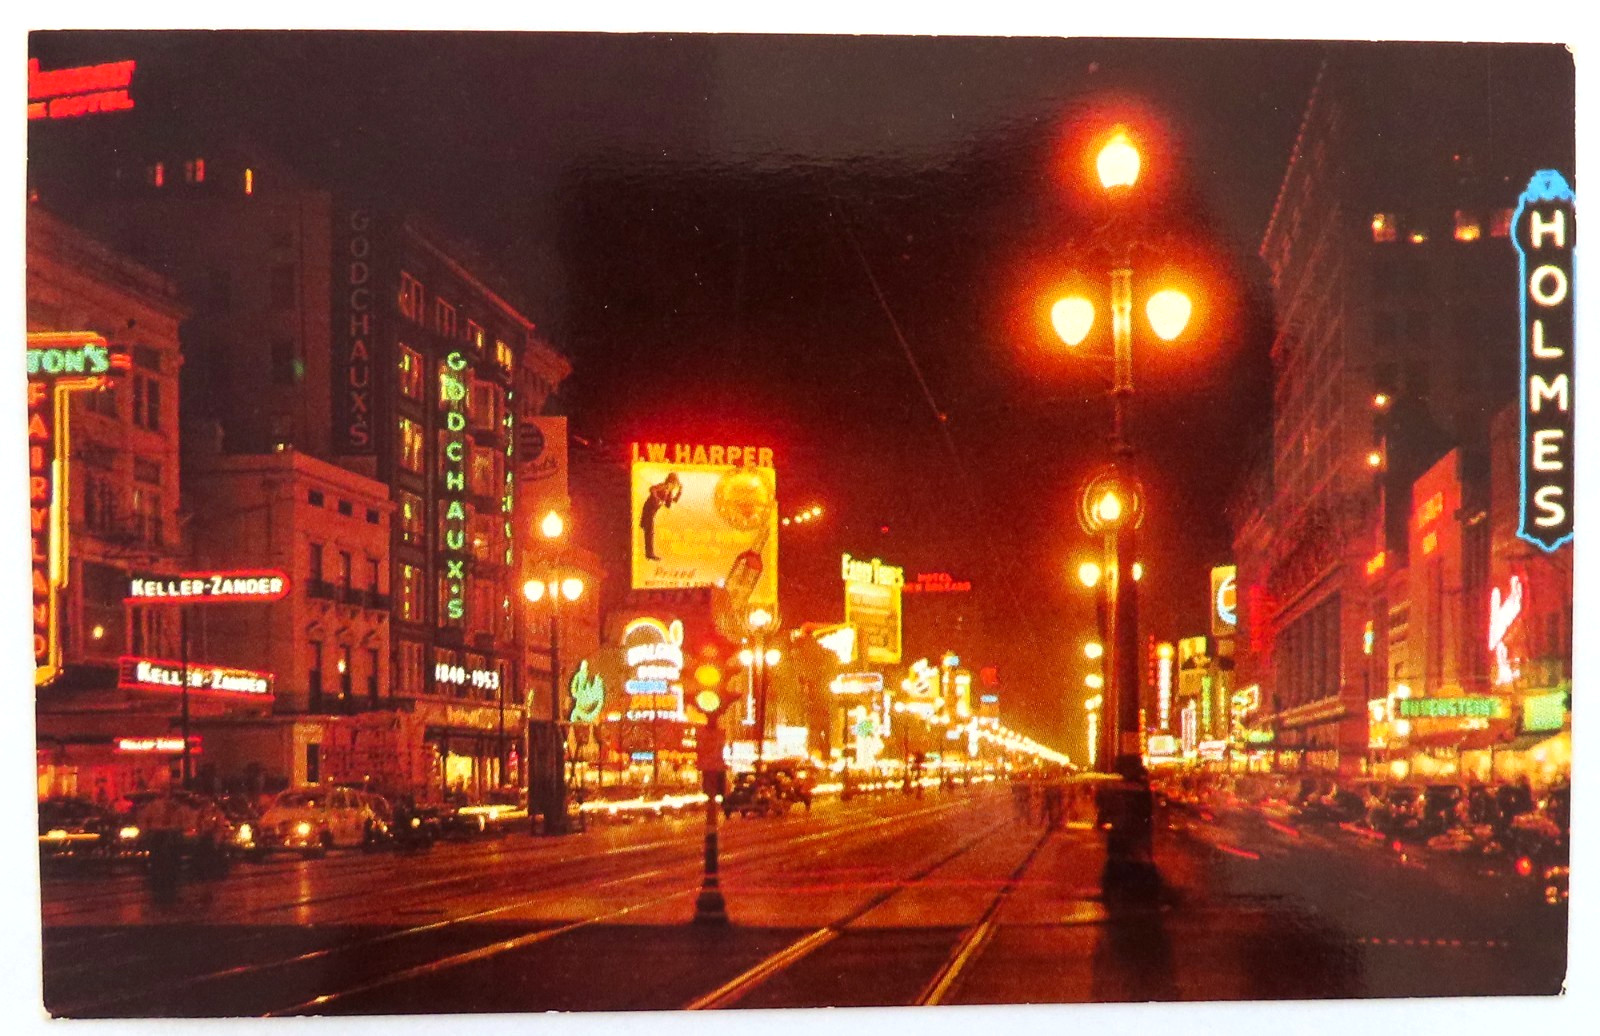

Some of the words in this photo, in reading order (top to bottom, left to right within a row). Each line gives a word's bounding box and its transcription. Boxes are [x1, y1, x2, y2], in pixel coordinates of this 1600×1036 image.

[1530, 209, 1568, 527] HOLMES
[674, 443, 774, 468] HARPER
[131, 575, 283, 597] KELLER-ZANDER
[136, 660, 267, 693] KELLER-ZANDER
